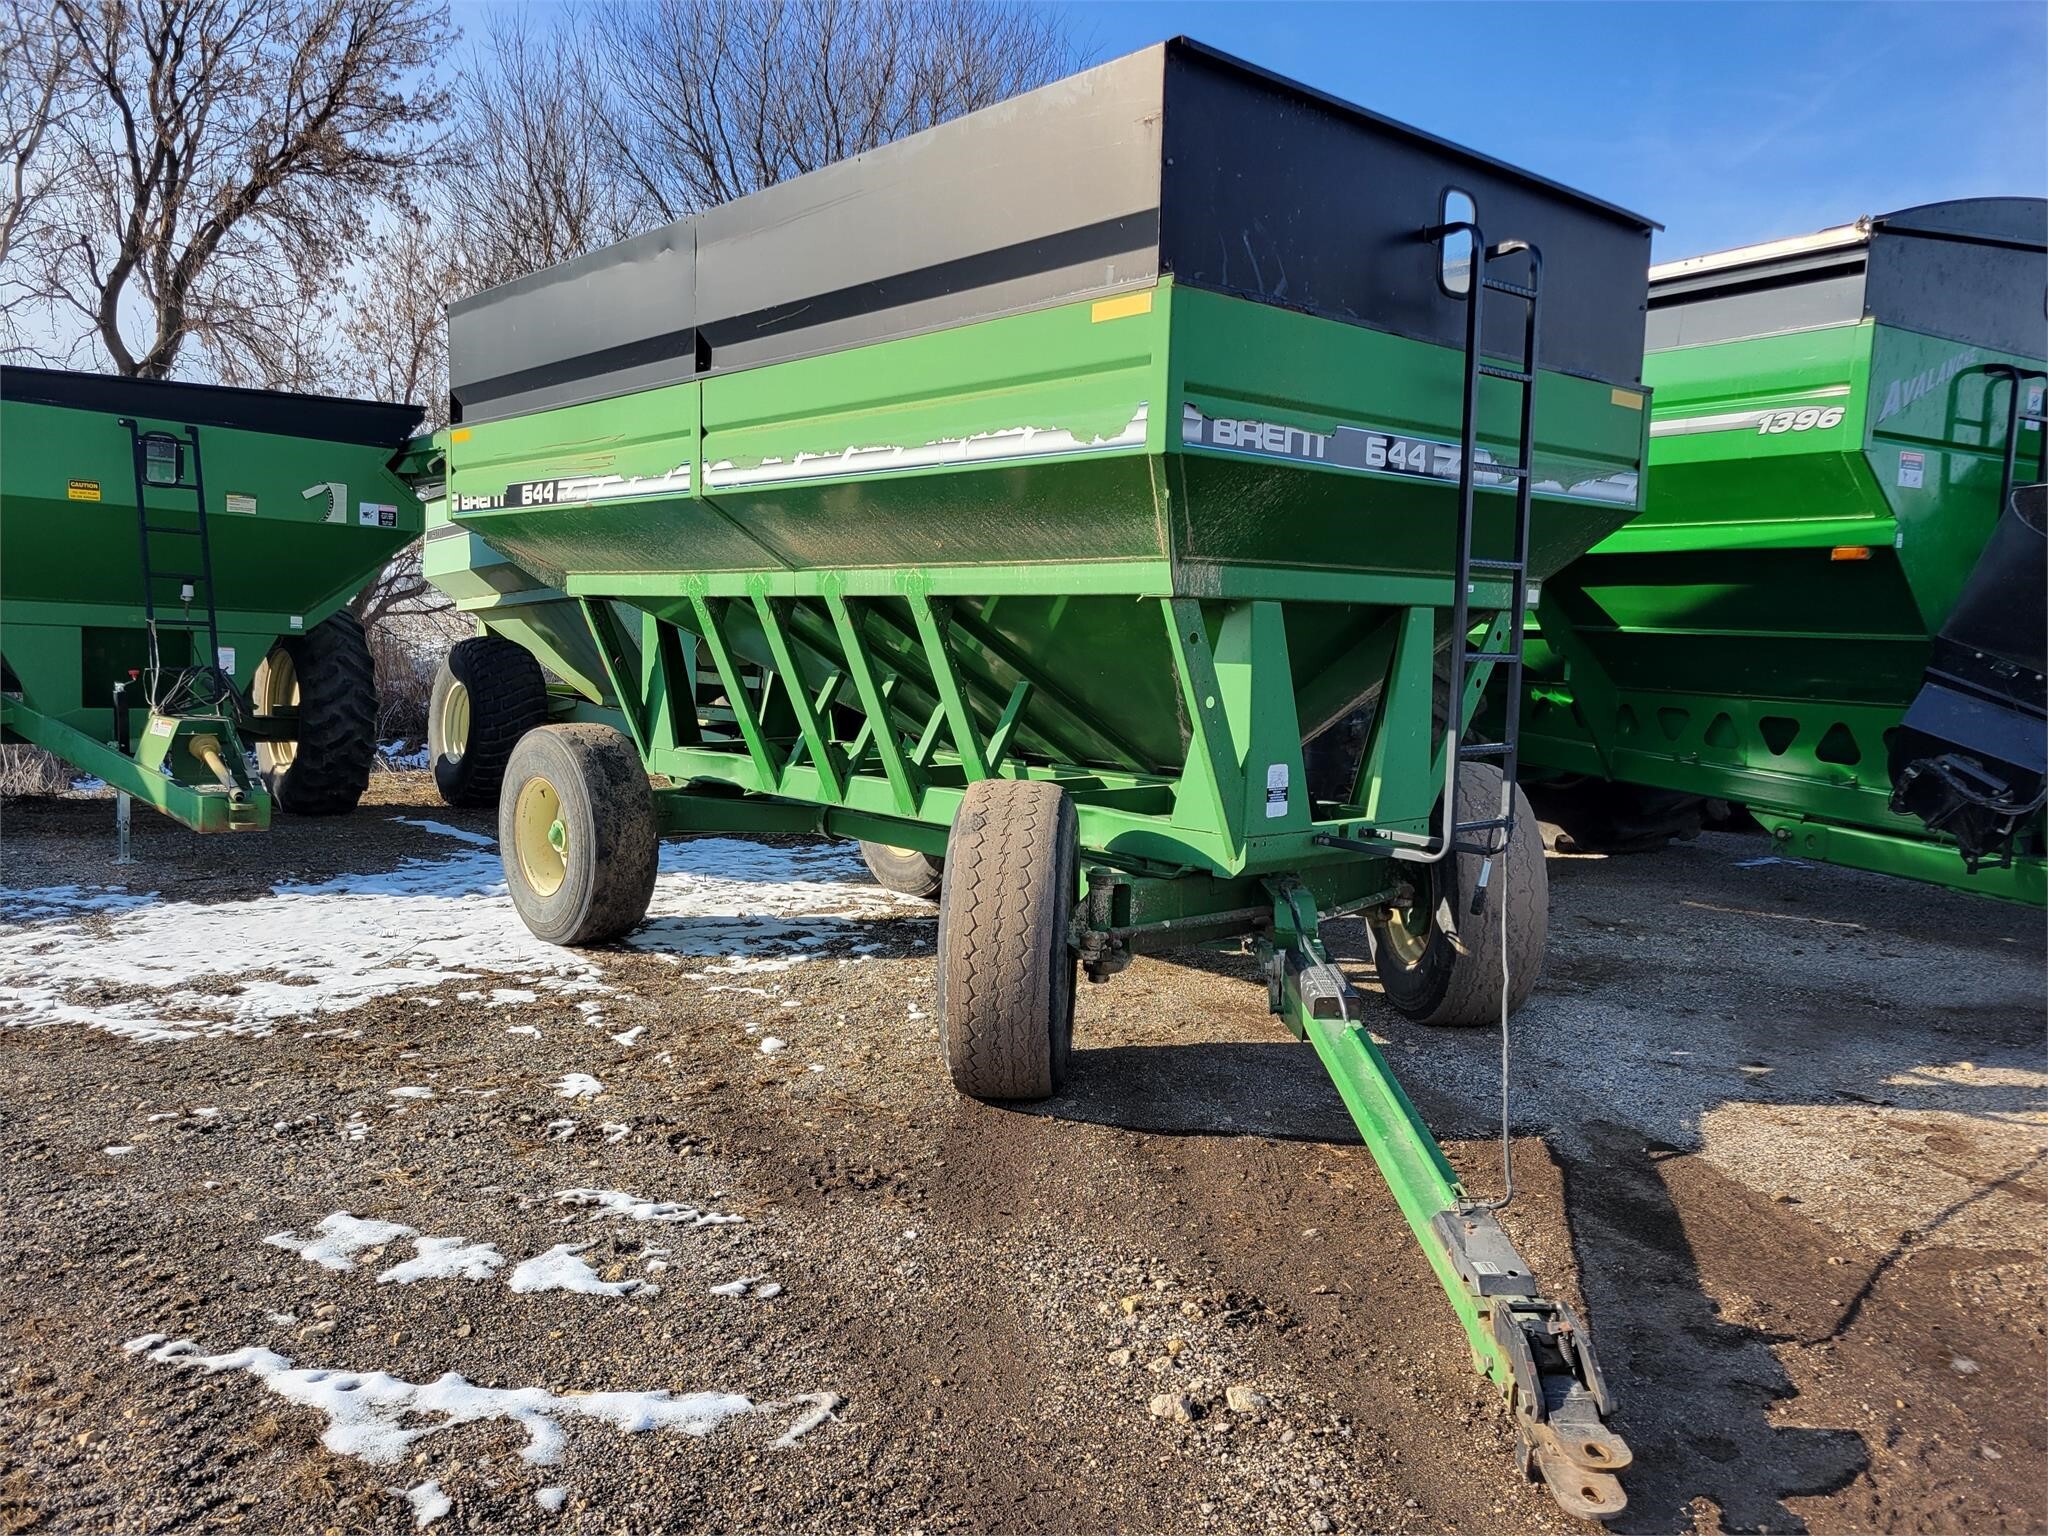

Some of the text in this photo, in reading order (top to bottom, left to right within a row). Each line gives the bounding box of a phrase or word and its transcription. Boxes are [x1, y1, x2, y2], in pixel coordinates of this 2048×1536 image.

[1757, 406, 1846, 435] 1396
[1213, 419, 1426, 473] BRENT 644
[70, 481, 98, 489] CAUTION
[522, 482, 554, 505] 644
